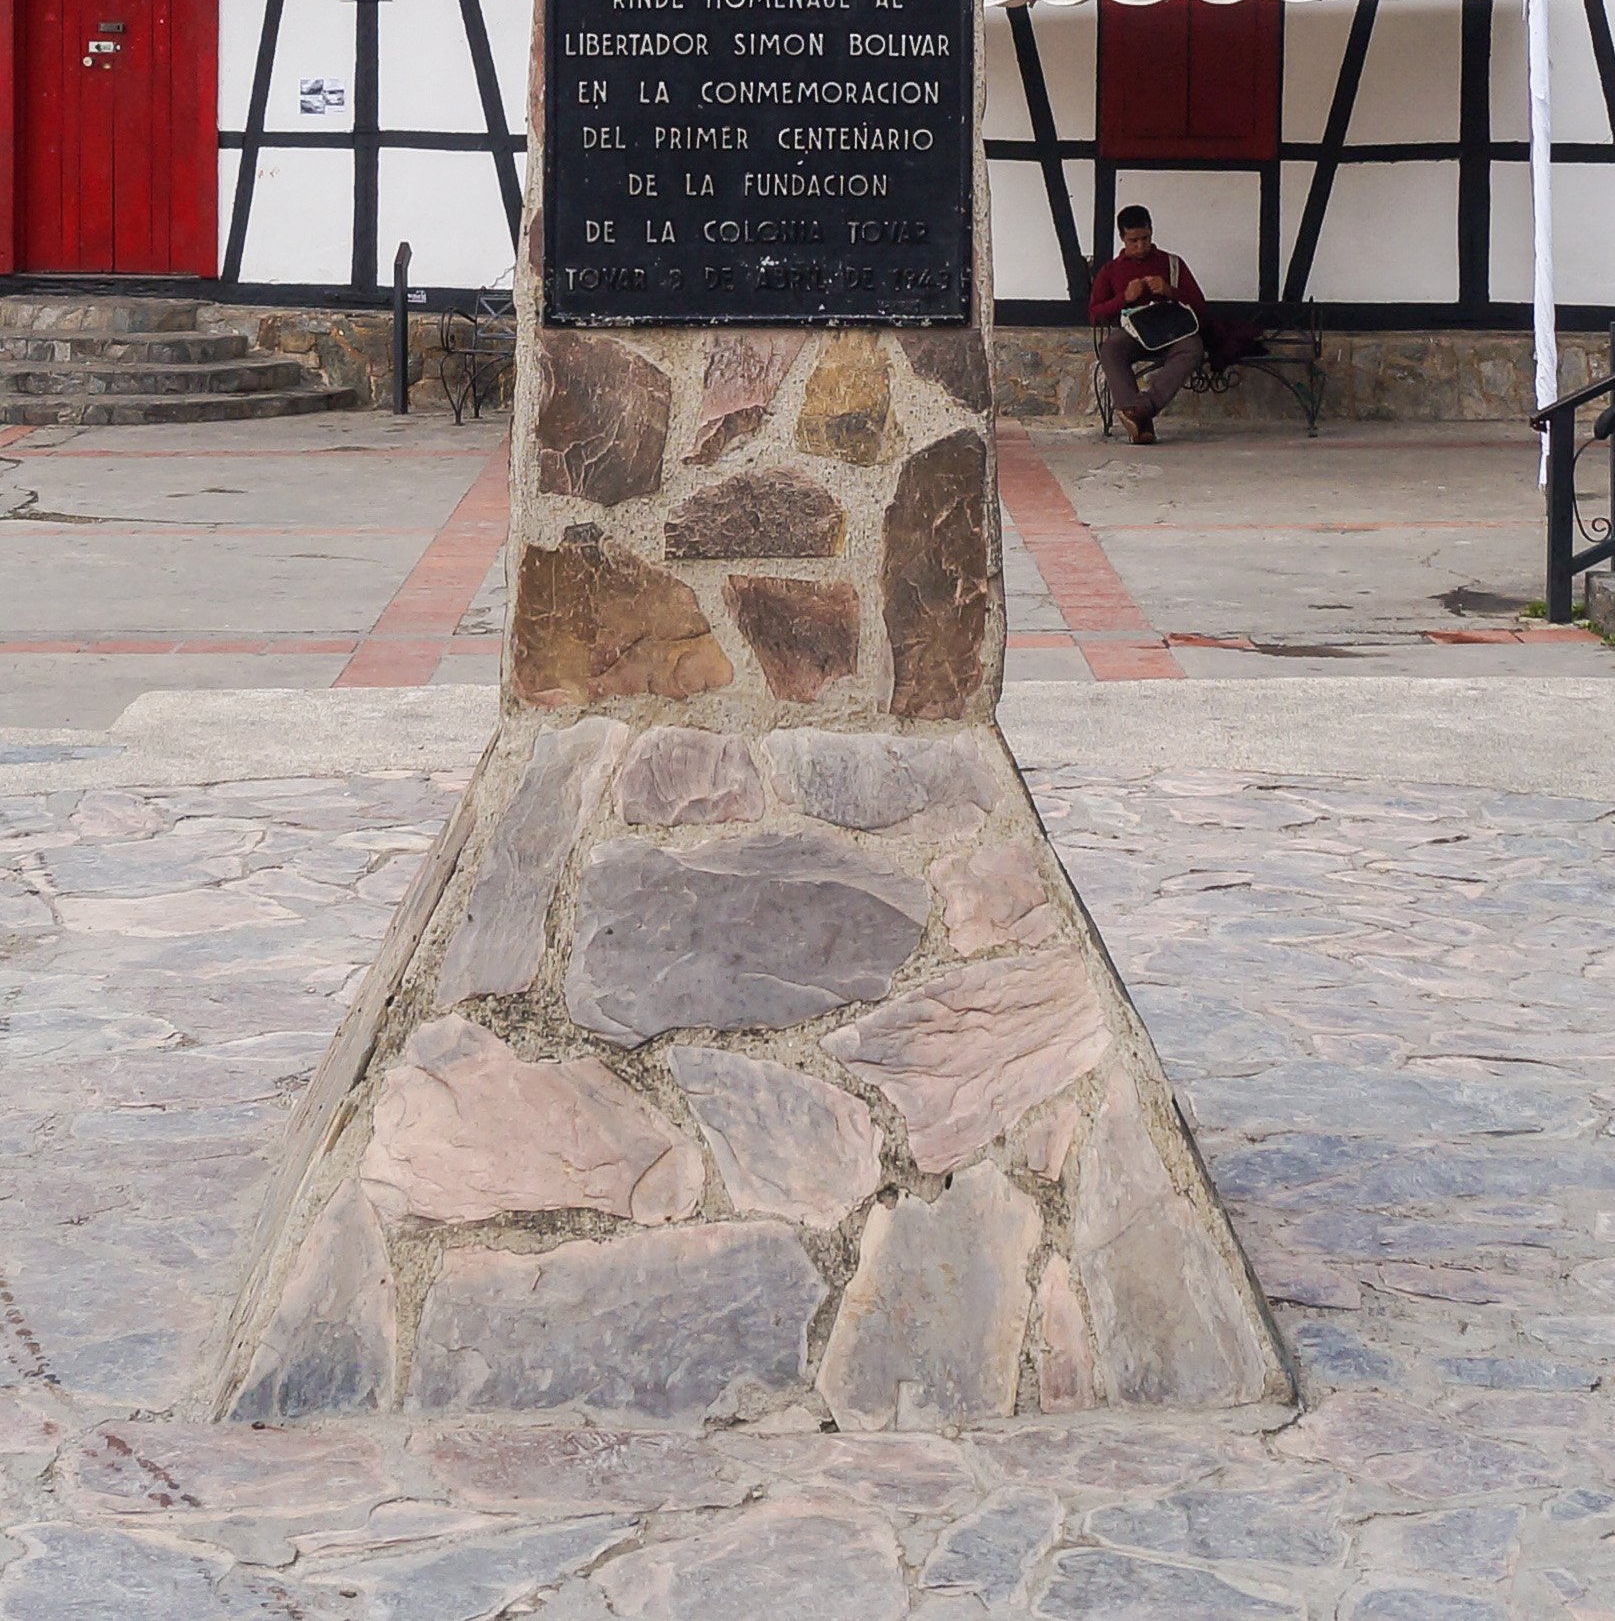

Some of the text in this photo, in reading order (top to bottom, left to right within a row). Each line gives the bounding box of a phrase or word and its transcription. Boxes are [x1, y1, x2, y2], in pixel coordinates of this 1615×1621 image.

[566, 33, 949, 56] LIBERTADOR SIMON BOLIVAR
[579, 81, 938, 104] EN LA CONMEMORACION
[583, 126, 933, 150] DEL PRIMER CENTENARIO
[629, 172, 886, 196] DE LA FUNDACION
[586, 220, 929, 245] DE LA COLONIA TOVAR
[565, 267, 647, 292] TOVAR
